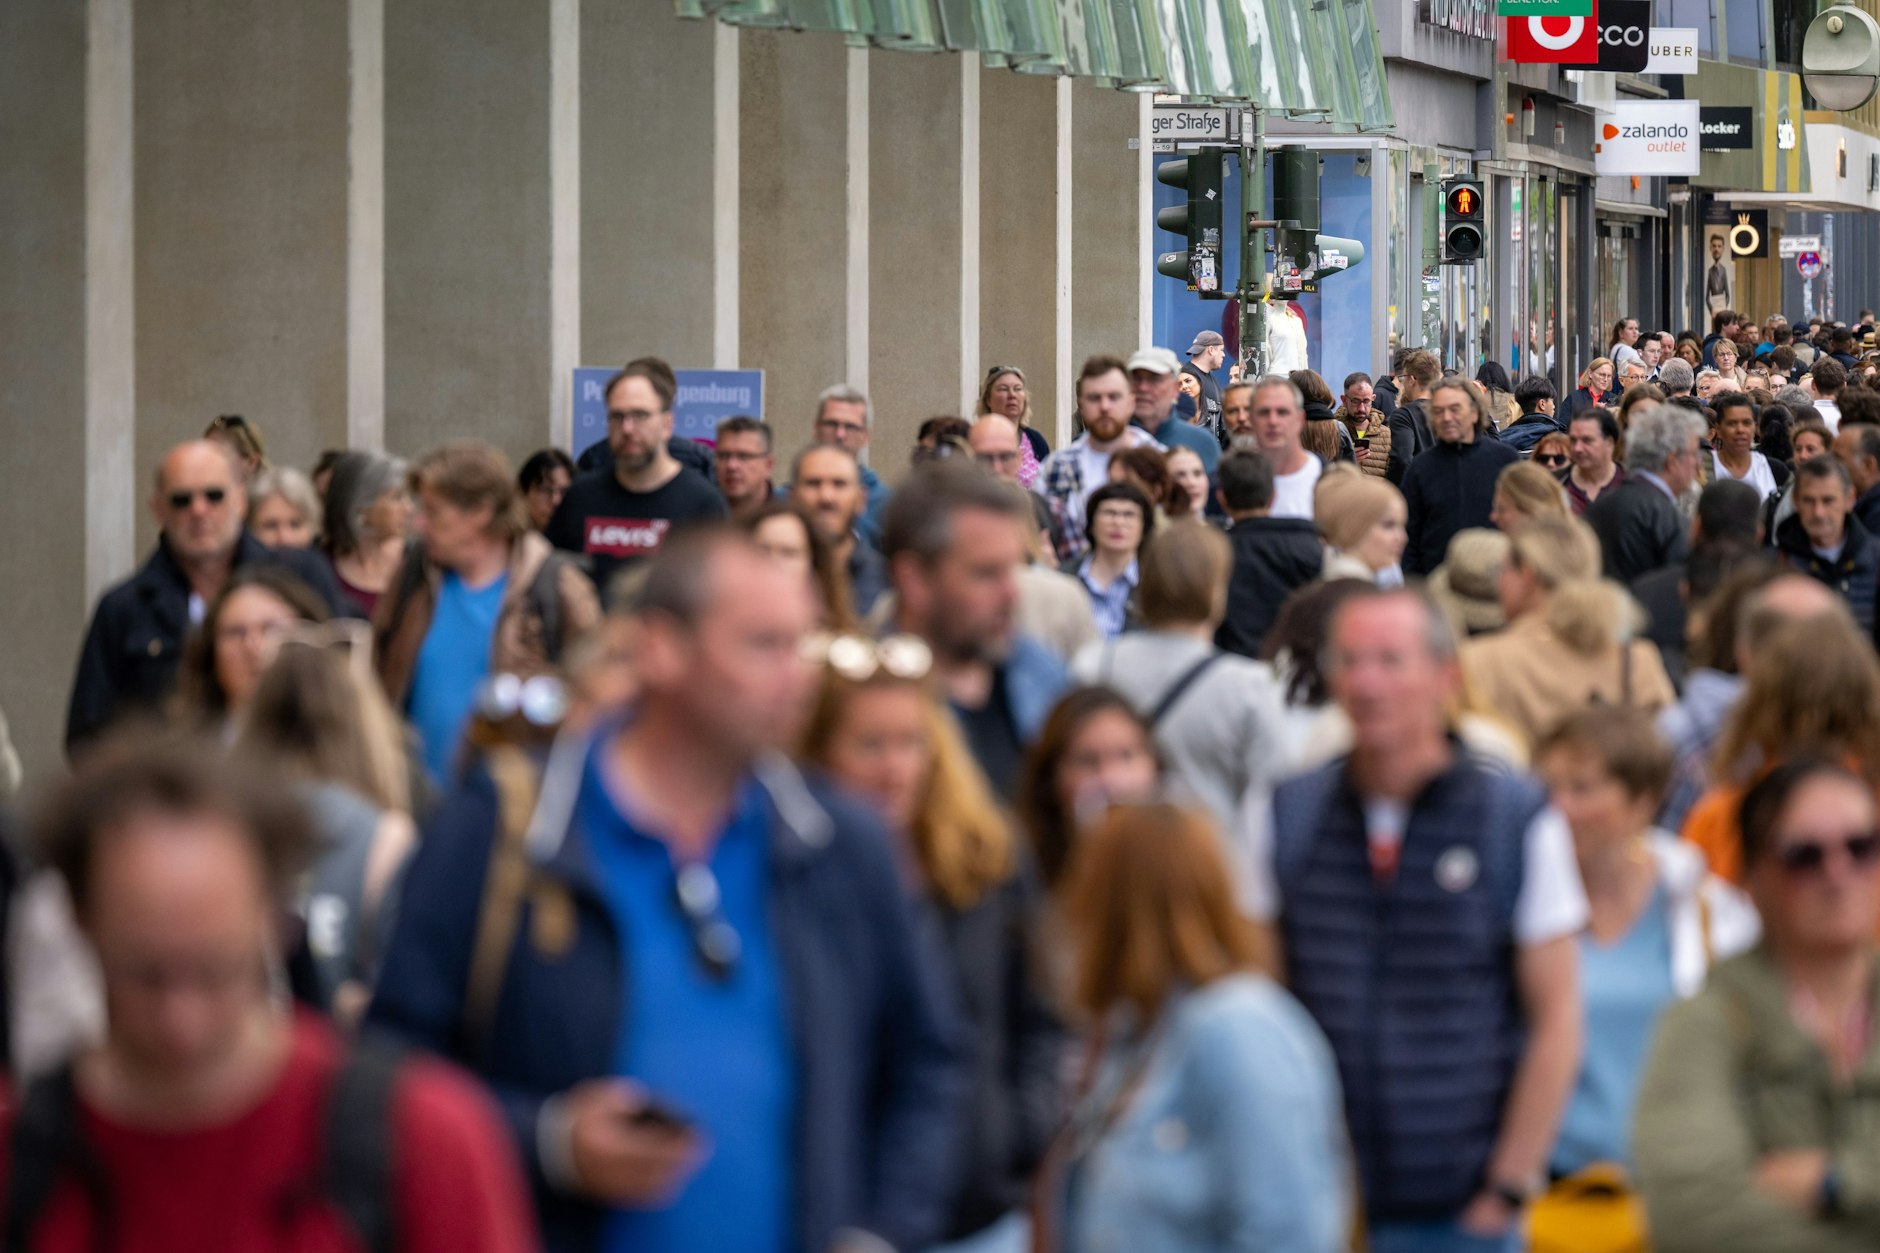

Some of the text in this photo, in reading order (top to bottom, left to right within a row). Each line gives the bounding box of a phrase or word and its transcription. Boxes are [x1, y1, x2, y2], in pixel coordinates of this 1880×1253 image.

[1176, 112, 1221, 134] Straße
[1622, 123, 1688, 138] zalando
[1647, 141, 1687, 153] outlet
